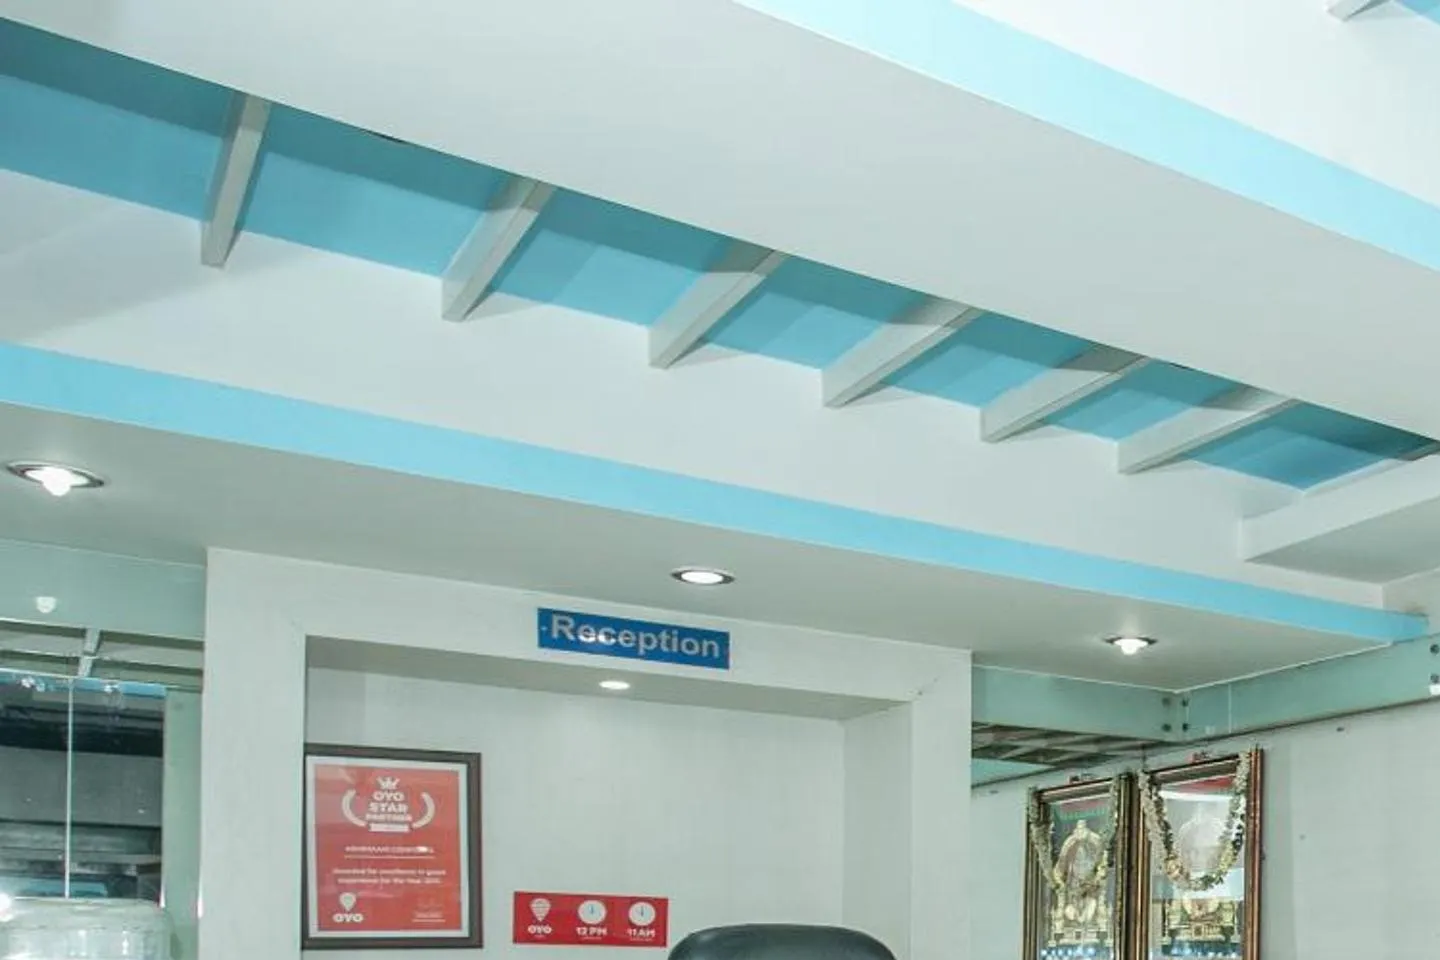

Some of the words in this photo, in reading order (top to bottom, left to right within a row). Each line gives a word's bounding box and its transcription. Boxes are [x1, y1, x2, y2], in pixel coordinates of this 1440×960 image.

[551, 614, 719, 658] Reception
[372, 790, 405, 801] OYO
[368, 802, 409, 813] STAR
[333, 913, 363, 923] OYO
[528, 925, 552, 934] OYO
[576, 927, 587, 936] 12
[589, 927, 608, 936] PM
[638, 929, 656, 938] AM
